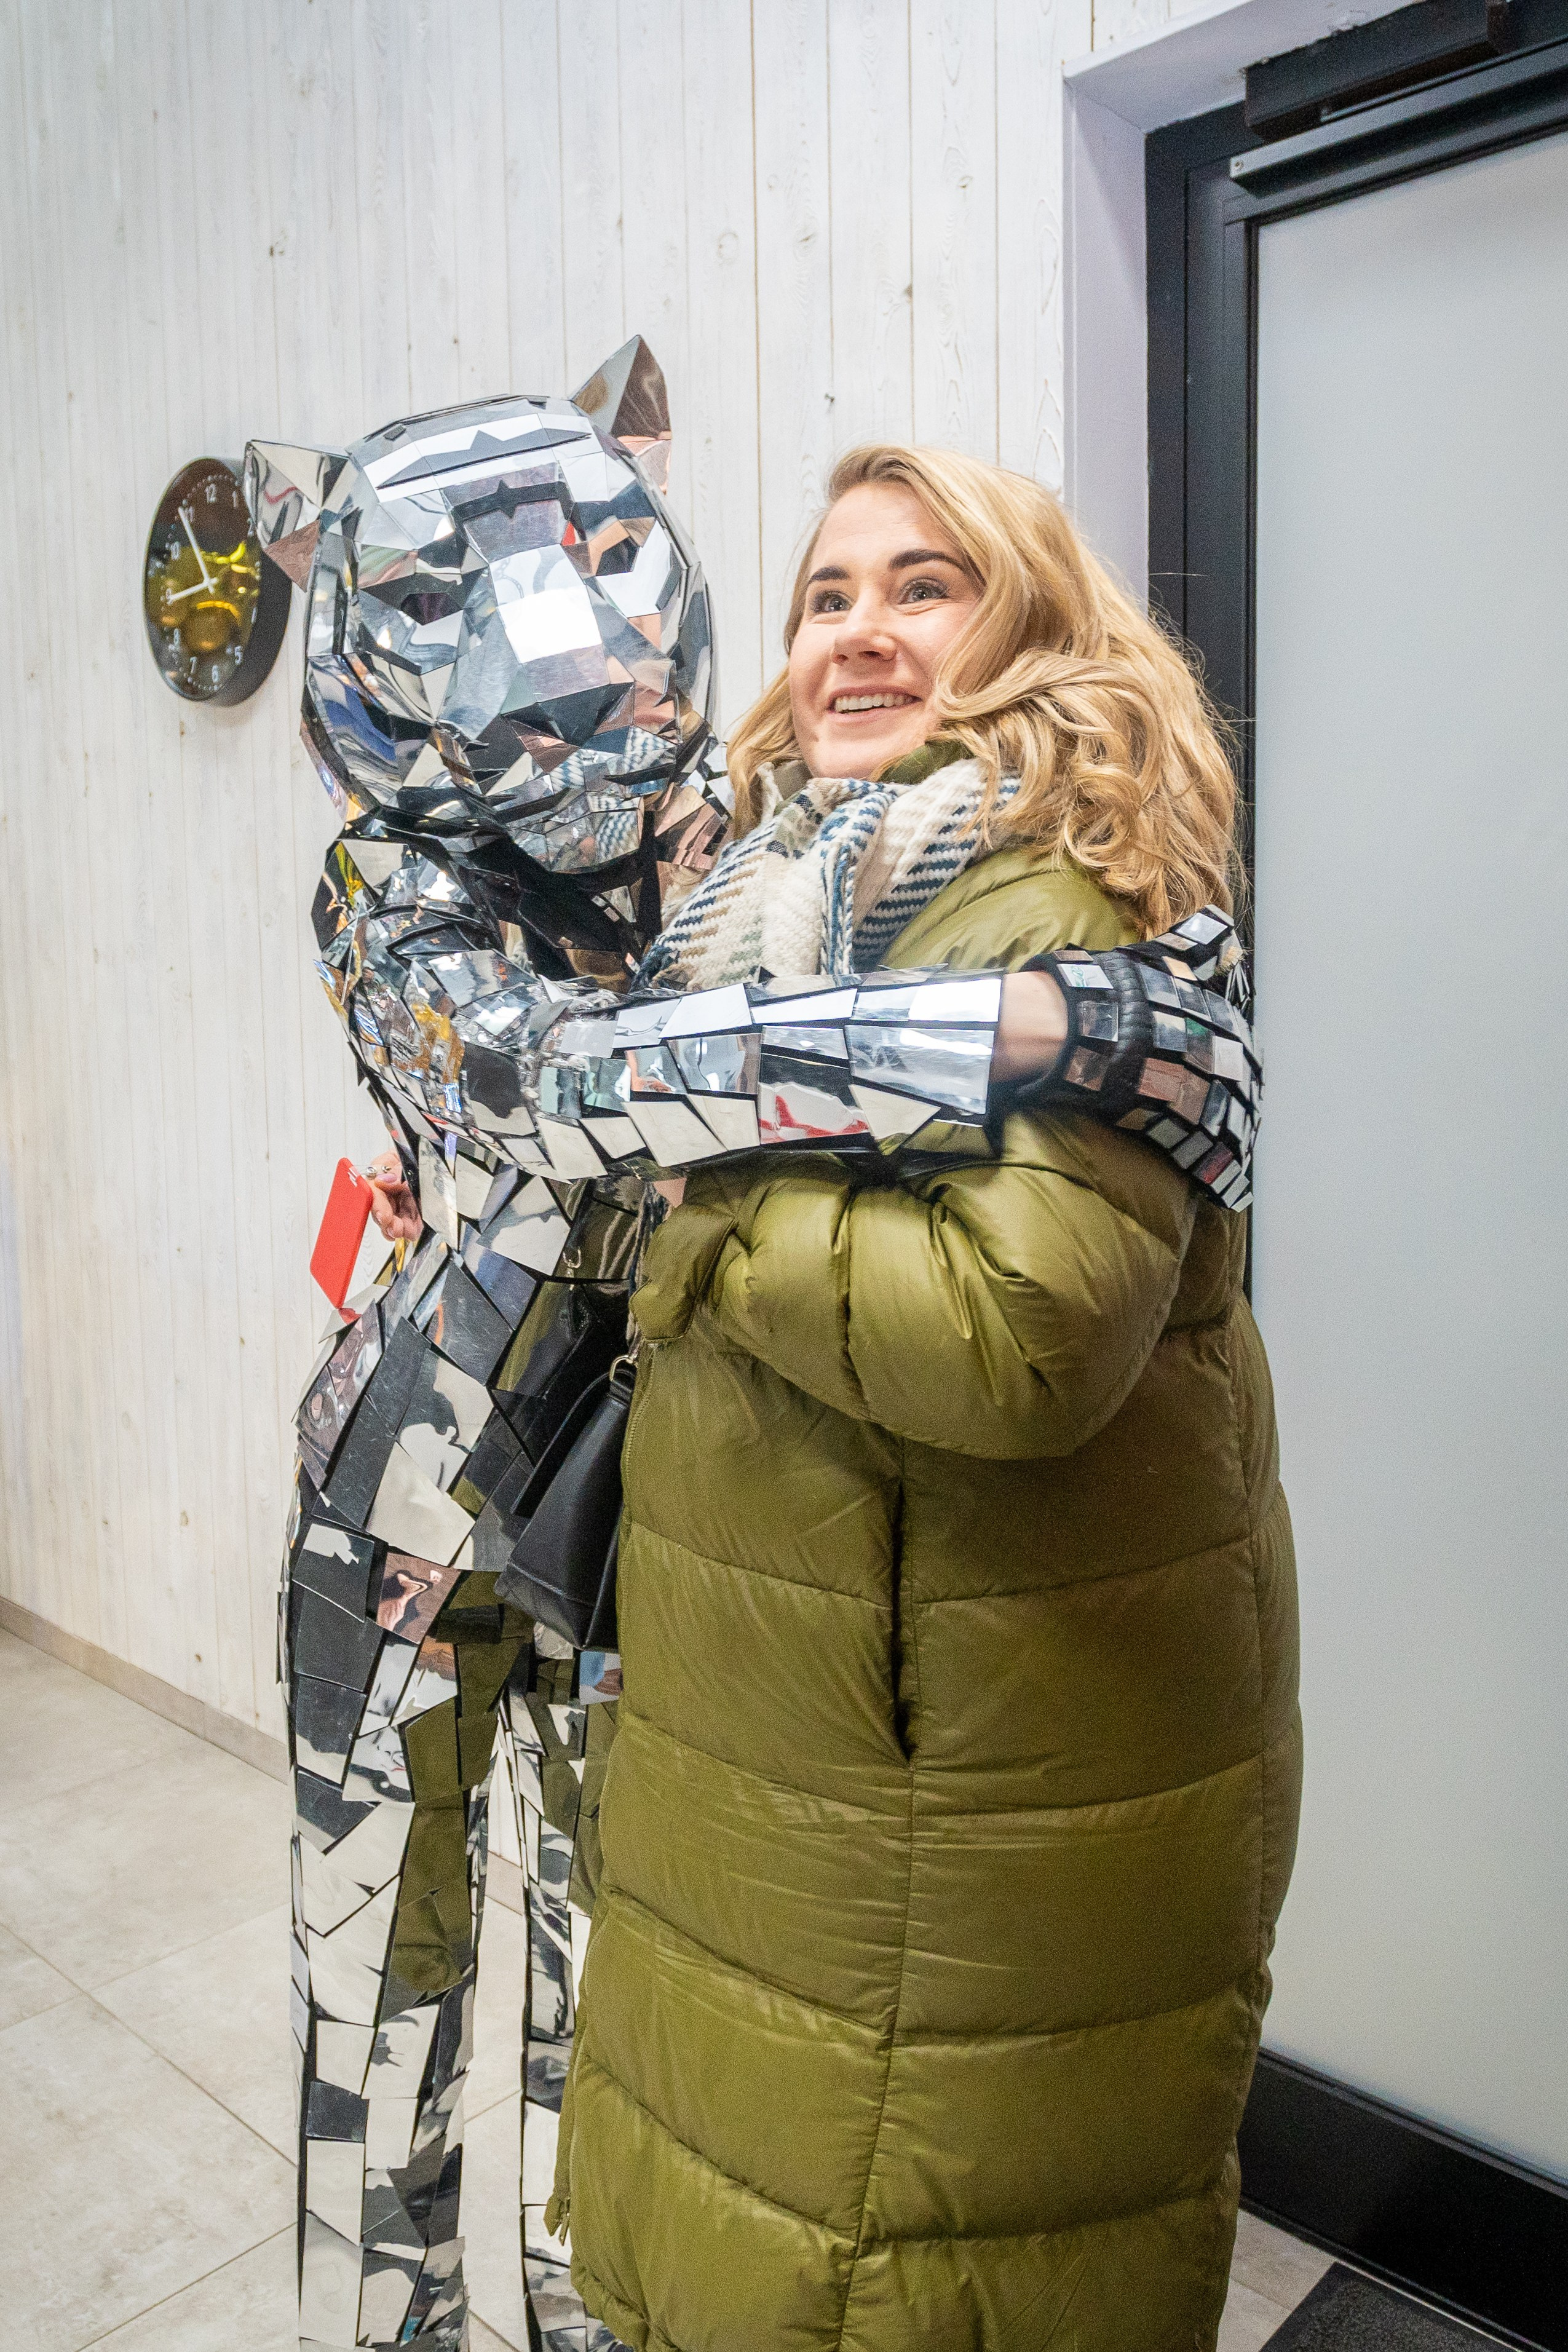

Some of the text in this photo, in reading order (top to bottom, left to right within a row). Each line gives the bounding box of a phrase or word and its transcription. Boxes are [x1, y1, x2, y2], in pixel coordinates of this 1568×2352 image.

[205, 483, 216, 503] 12
[170, 541, 180, 561] 10
[173, 628, 180, 646] 8
[234, 645, 243, 665] 5
[189, 656, 197, 674] 7
[212, 665, 218, 683] 6
